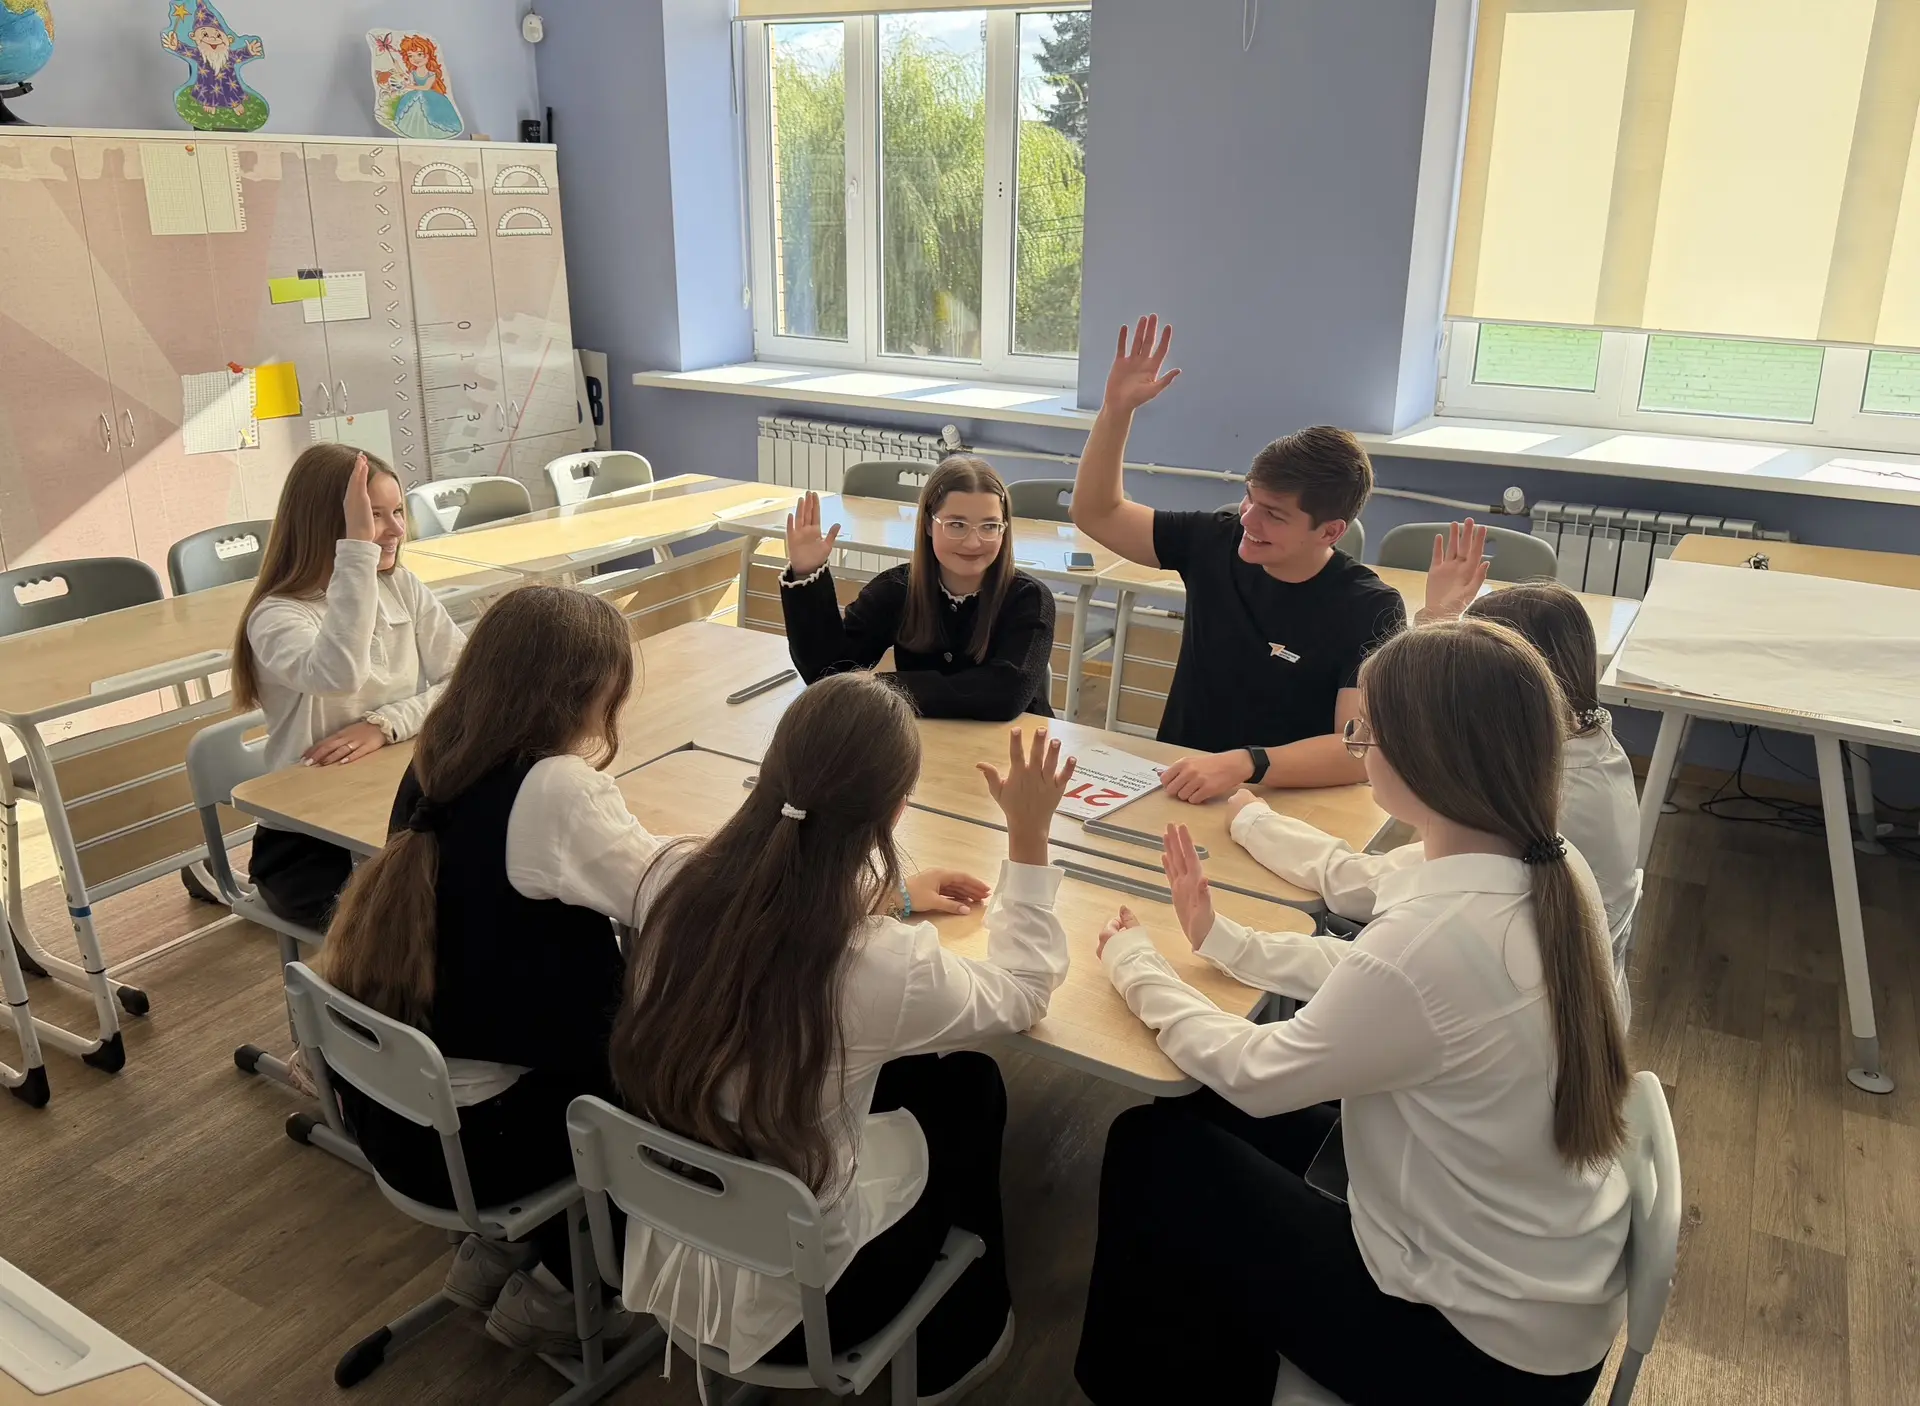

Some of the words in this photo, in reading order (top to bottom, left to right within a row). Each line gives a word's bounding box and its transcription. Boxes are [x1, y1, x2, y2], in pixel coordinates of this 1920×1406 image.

[457, 320, 471, 330] 0
[461, 352, 474, 361] 1
[463, 381, 478, 391] 2
[467, 412, 481, 422] 3
[471, 443, 485, 453] 4
[1063, 783, 1129, 807] 21
